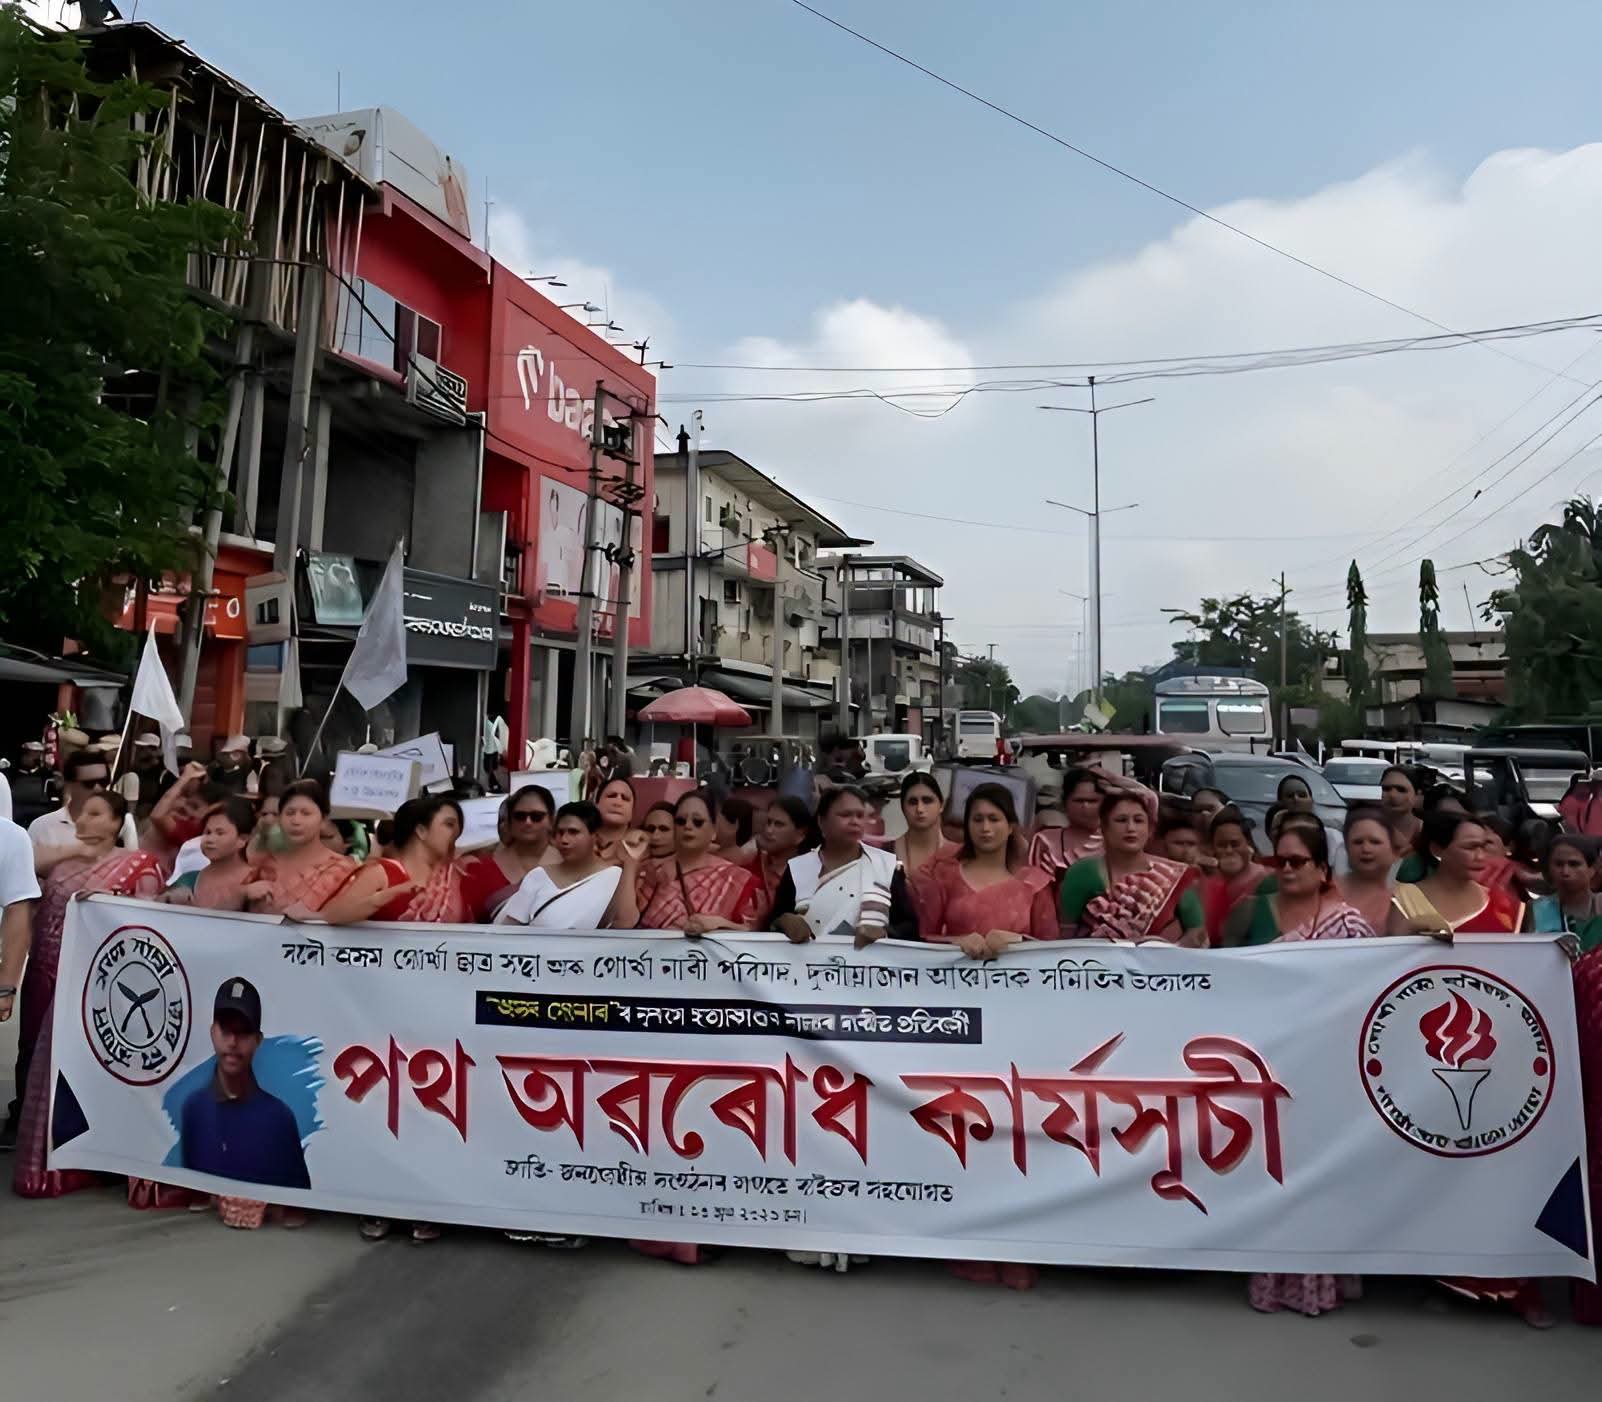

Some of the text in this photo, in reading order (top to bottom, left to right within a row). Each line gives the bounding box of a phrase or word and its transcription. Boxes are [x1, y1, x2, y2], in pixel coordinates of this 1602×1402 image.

[333, 1034, 476, 1143] পথ
[495, 1052, 874, 1167] অৱৰোধ
[899, 1033, 1292, 1215] কাৰ্যসূচী
